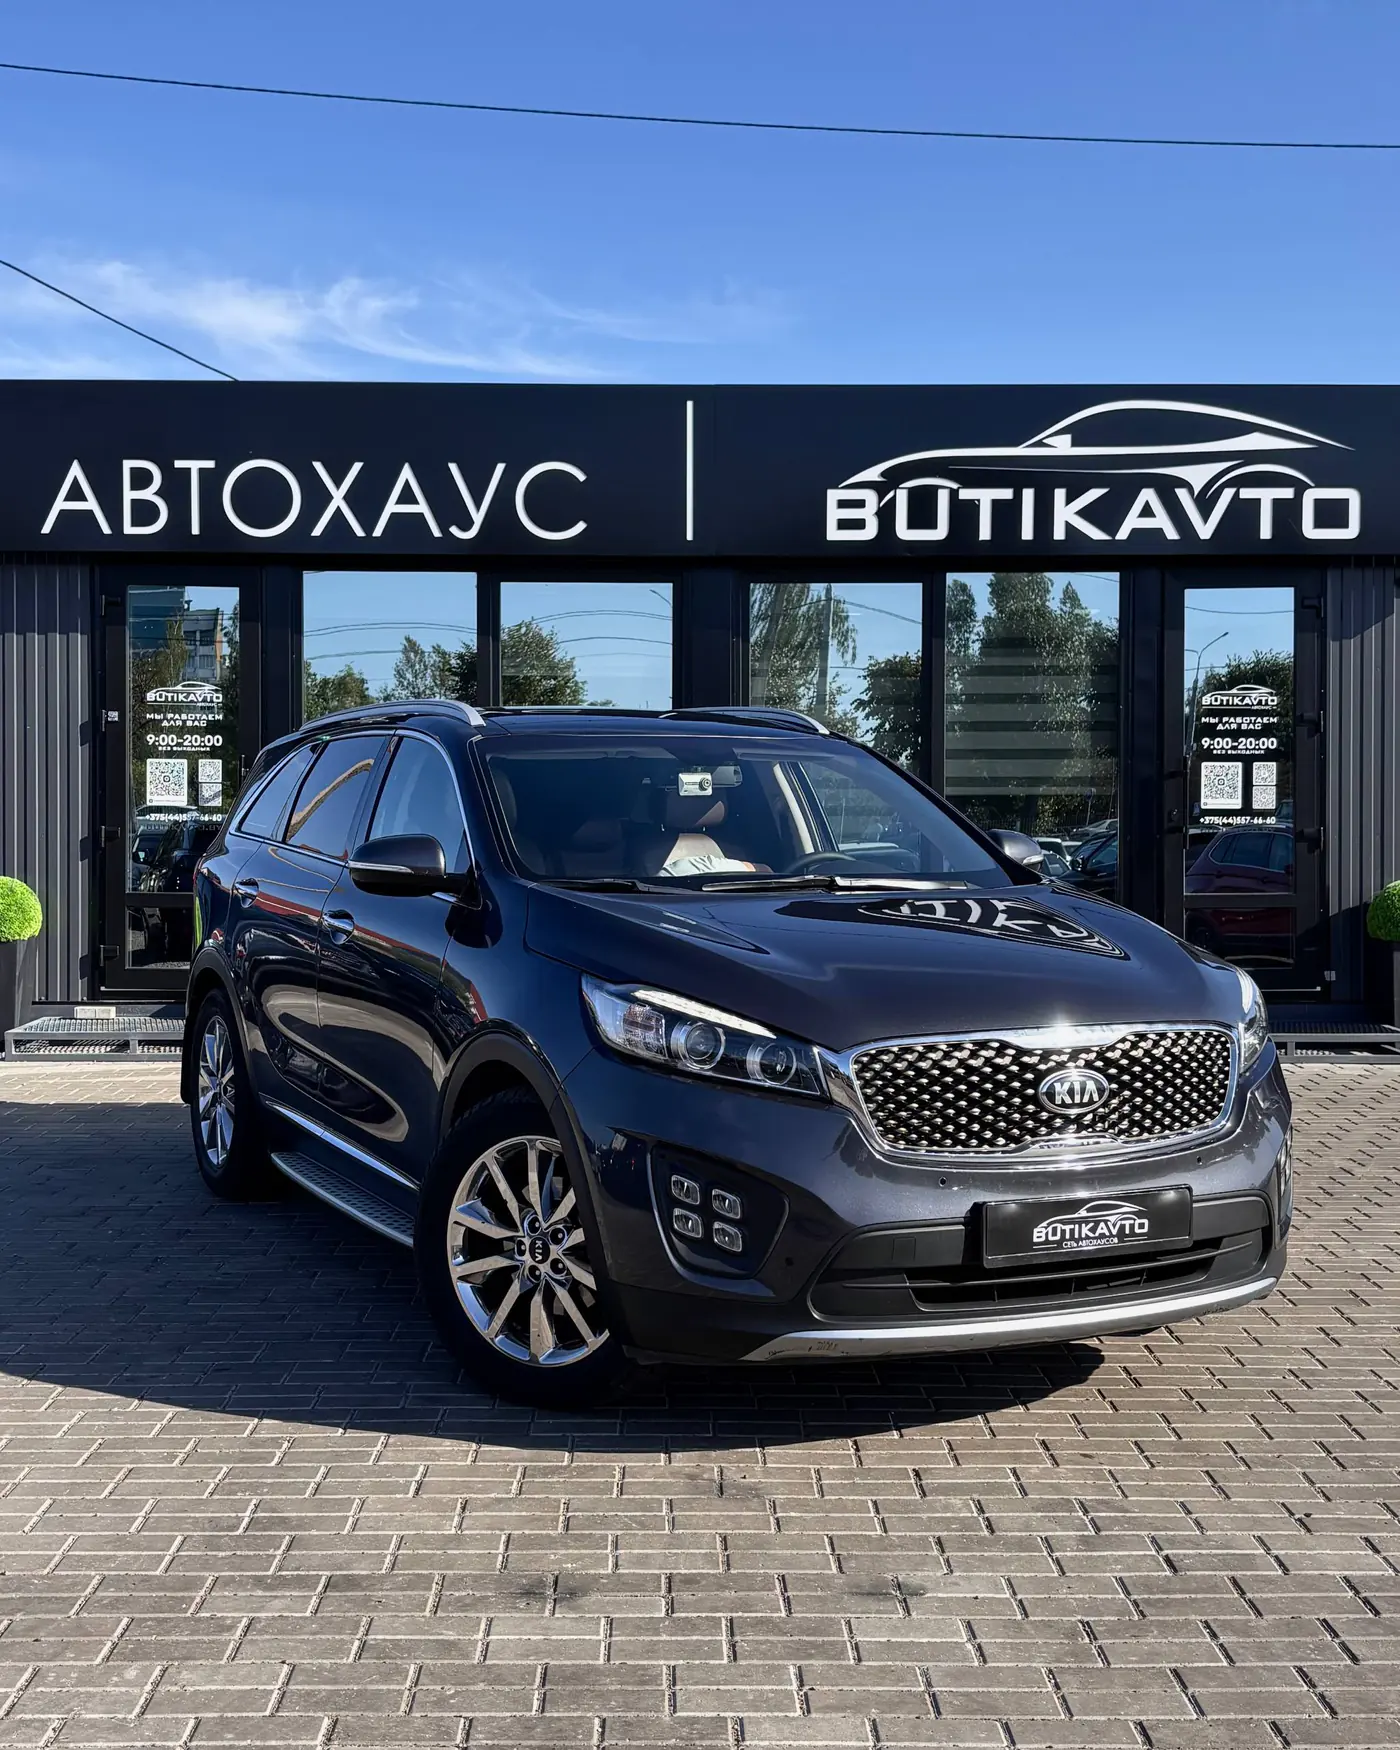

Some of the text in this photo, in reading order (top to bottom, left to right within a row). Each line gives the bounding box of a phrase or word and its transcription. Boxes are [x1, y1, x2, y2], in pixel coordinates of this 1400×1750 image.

[41, 458, 588, 541] АВТОХАУС
[826, 485, 1361, 541] BUTIKAVTO
[146, 692, 223, 702] BUTIKAVTO
[1201, 695, 1278, 705] BUTIKAVTO
[146, 734, 223, 747] 9:00-20:00
[1201, 737, 1278, 749] 9:00-20:00
[1199, 816, 1276, 825] +375(44)557-66-60
[1053, 1080, 1100, 1105] KIA
[1033, 1218, 1149, 1242] BUTIKAVTO
[1078, 1236, 1119, 1247] АВТОХАУСОВ
[535, 1240, 543, 1261] KIA
